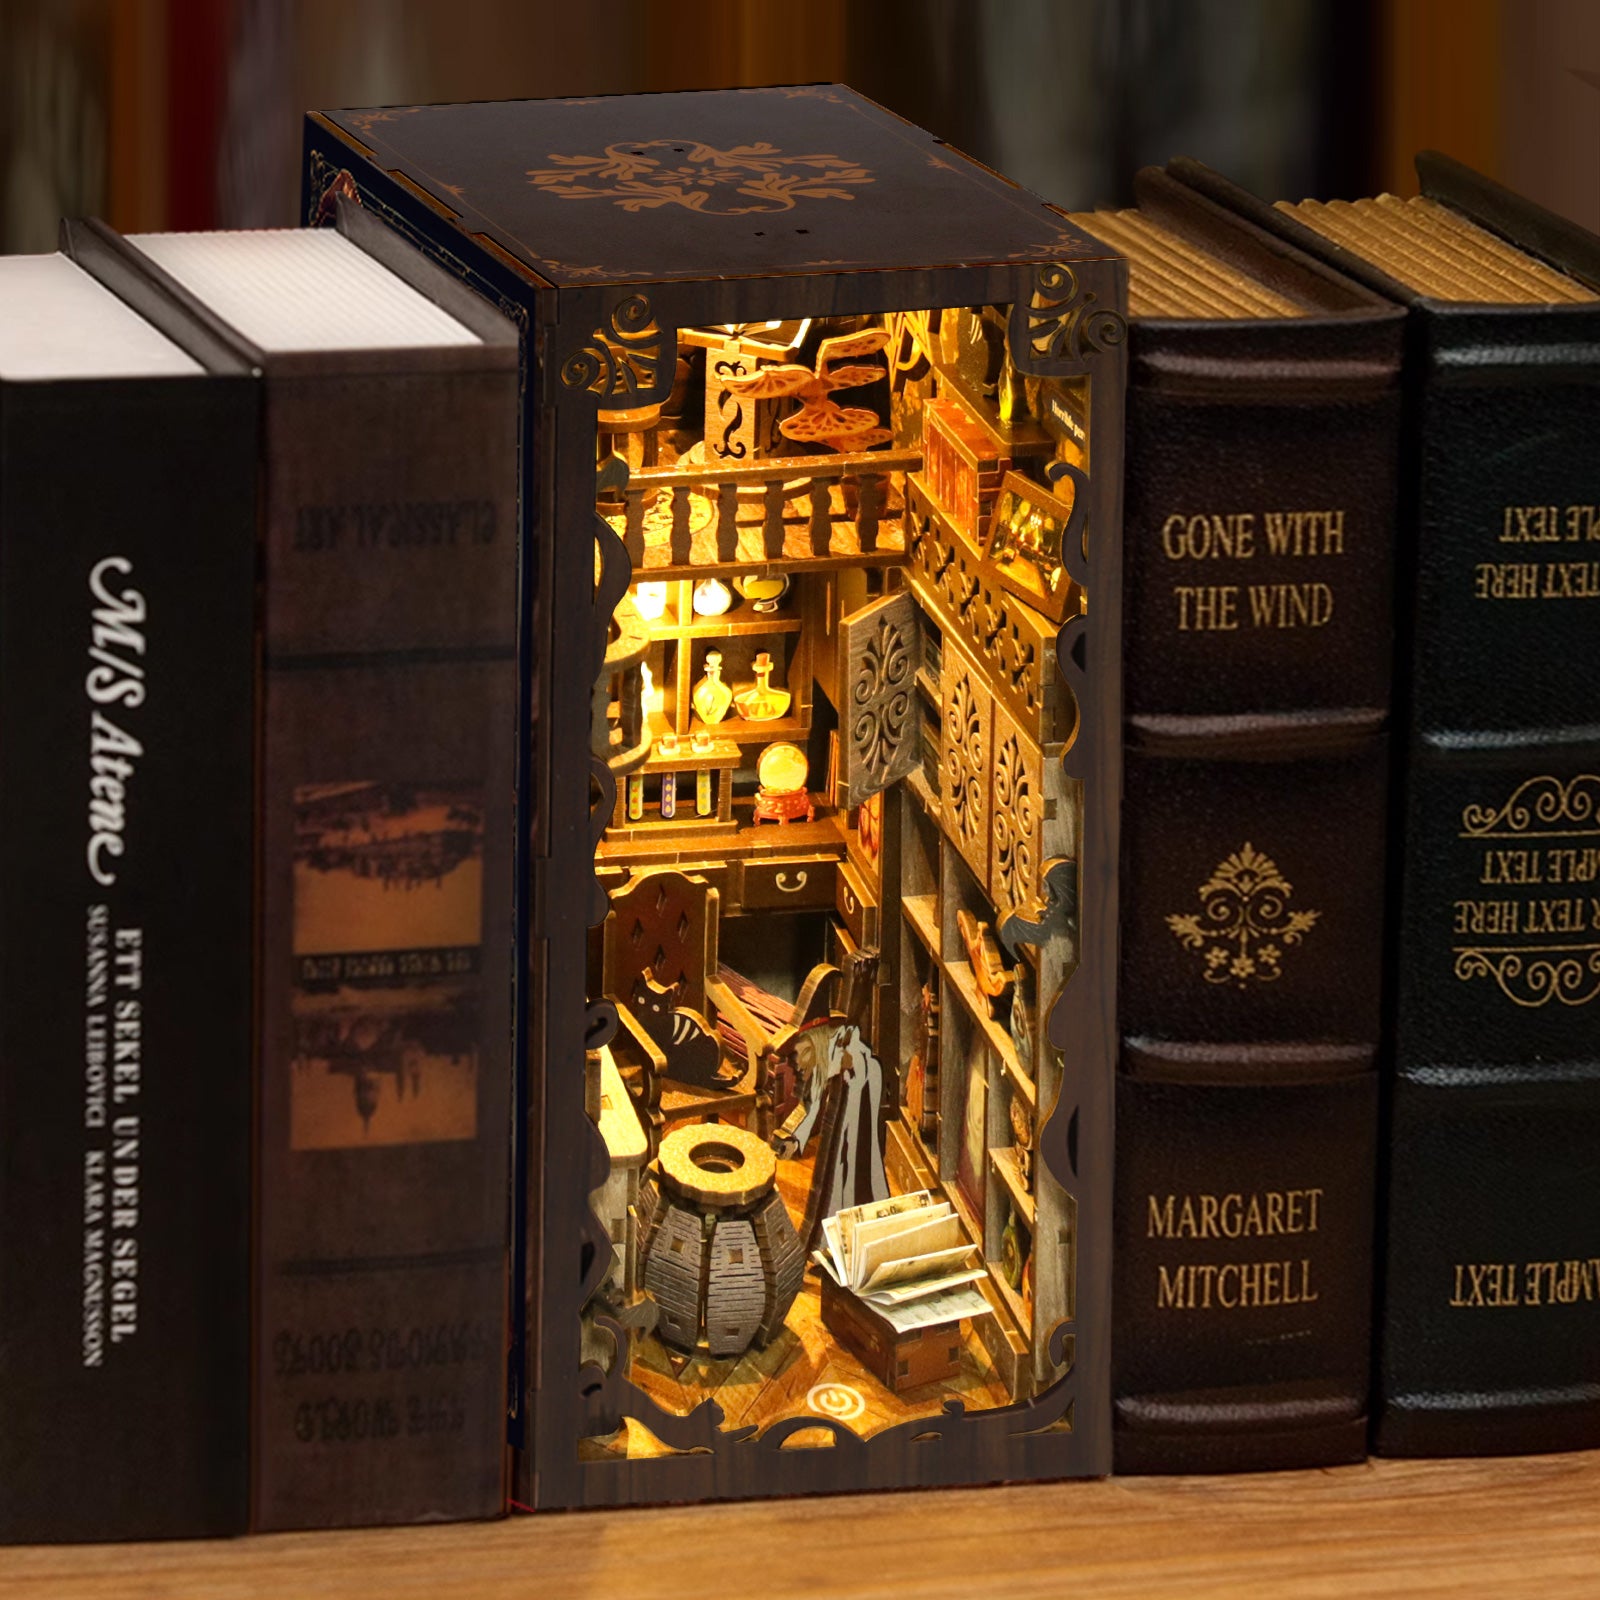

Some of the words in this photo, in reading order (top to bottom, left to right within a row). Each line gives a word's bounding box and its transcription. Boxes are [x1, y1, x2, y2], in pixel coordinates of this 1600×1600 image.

[1163, 514, 1255, 560] GONE
[1264, 510, 1344, 556] WITH
[1499, 506, 1560, 543] TEXT
[1474, 563, 1539, 599] HERE
[85, 556, 146, 708] M/S
[1173, 585, 1240, 631] THE
[1248, 583, 1333, 628] WIND
[87, 710, 144, 886] Atene
[1479, 850, 1543, 885] TEXT
[1453, 900, 1519, 934] HERE
[1522, 898, 1587, 934] TEXT
[86, 904, 109, 1008] SUSANNA
[114, 928, 143, 990] ETT
[112, 1001, 142, 1104] SEKEL
[83, 1151, 106, 1225] KLARA
[1147, 1188, 1324, 1239] MARGARET
[82, 1228, 105, 1367] MAGNUSSON
[109, 1238, 139, 1343] SEGEL
[1157, 1259, 1319, 1309] MITCHELL
[1450, 1263, 1519, 1307] TEXT
